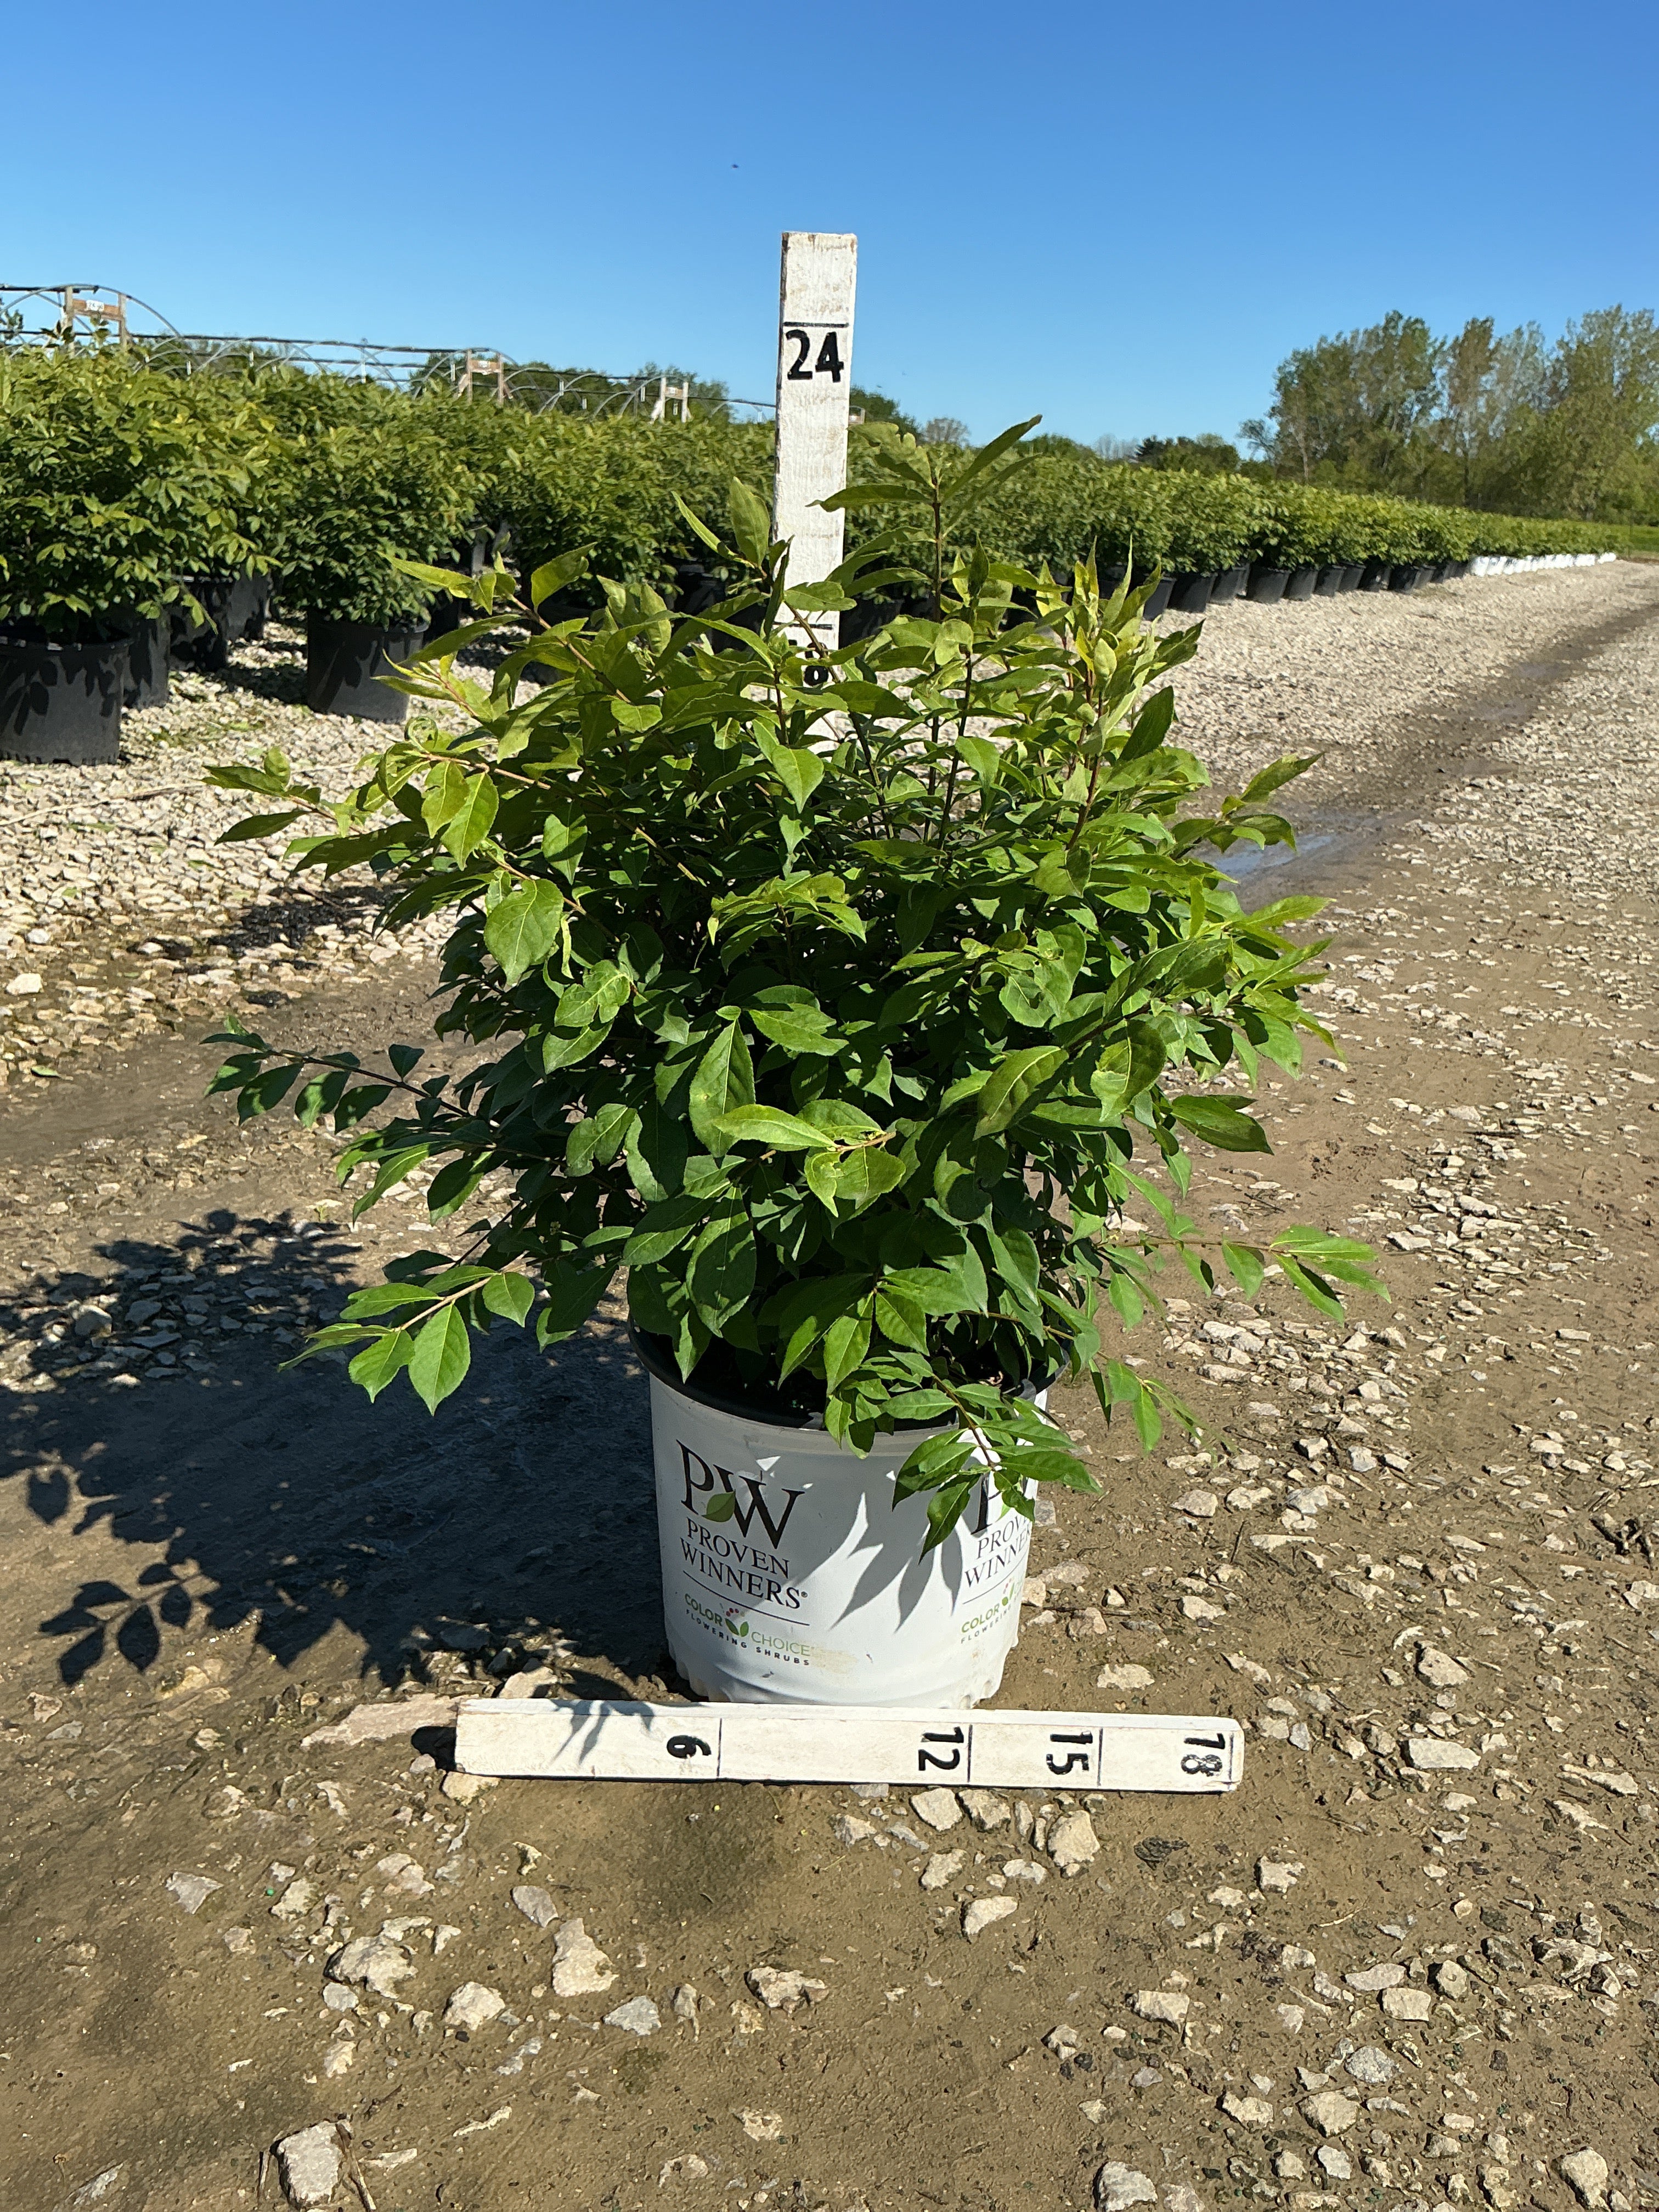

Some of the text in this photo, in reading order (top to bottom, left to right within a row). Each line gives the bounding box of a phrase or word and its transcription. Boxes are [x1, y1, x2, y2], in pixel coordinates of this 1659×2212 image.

[785, 329, 845, 383] 24
[788, 639, 830, 687] 8
[676, 1438, 805, 1550] PW
[686, 1516, 789, 1579] PROVEN
[977, 1515, 1028, 1560] PROV
[685, 1593, 811, 1657] COLOR CHOICE
[686, 1609, 810, 1666] FLOWERING SHRUBS
[961, 1602, 1000, 1633] COLOR
[666, 1735, 712, 1759] 6
[918, 1726, 964, 1771] 12
[1046, 1730, 1094, 1775] 15
[1180, 1733, 1226, 1777] 18
